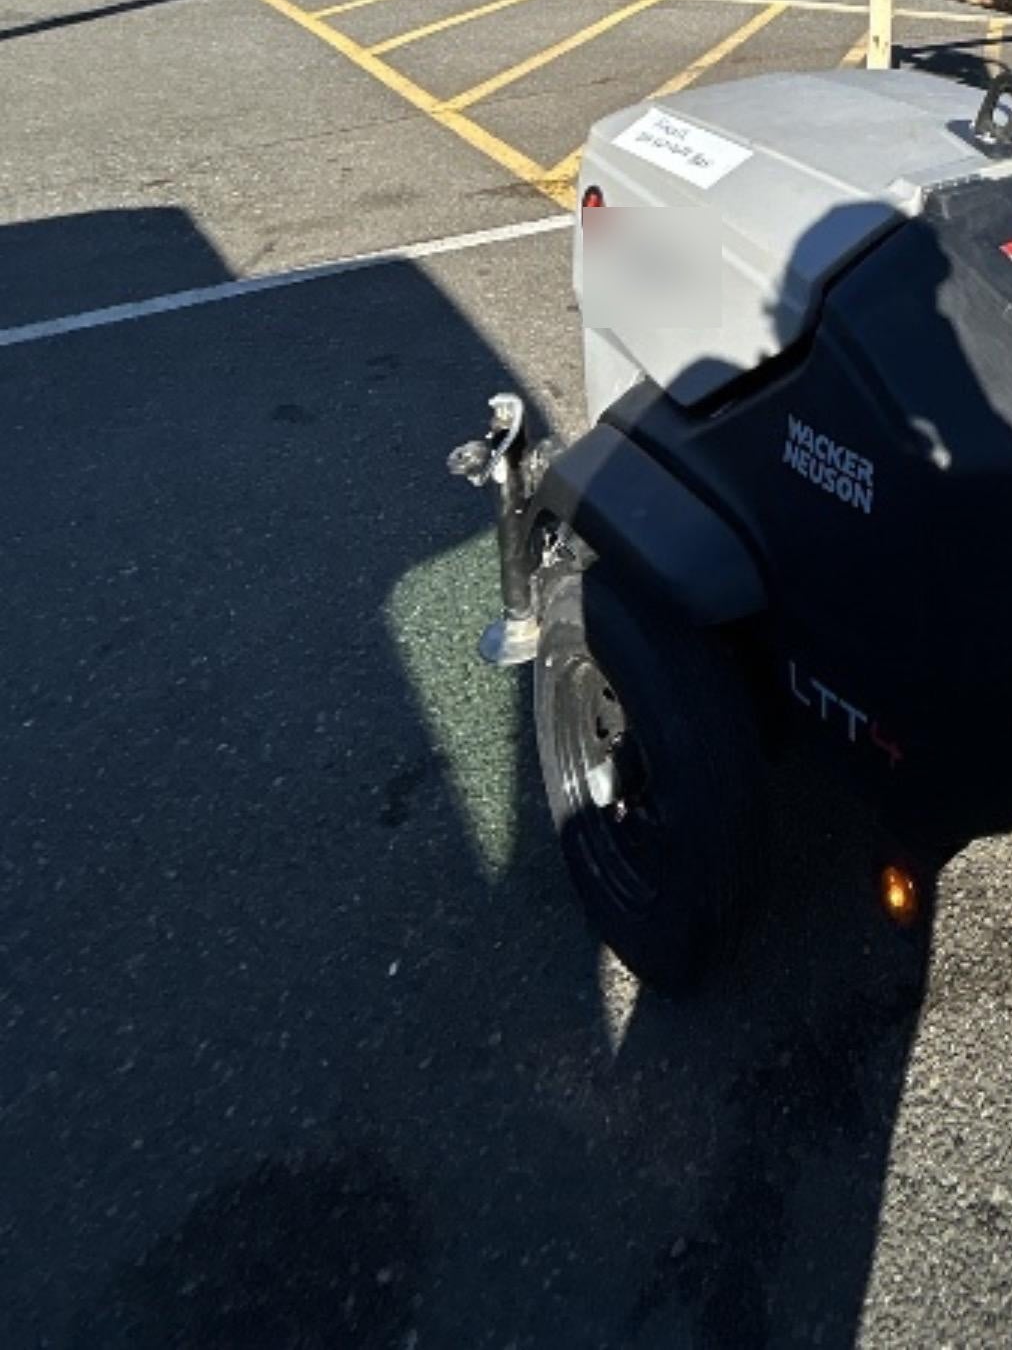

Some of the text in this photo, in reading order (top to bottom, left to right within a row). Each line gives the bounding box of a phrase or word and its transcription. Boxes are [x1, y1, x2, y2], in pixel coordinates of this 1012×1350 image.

[783, 441, 873, 514] NEUSON
[788, 413, 874, 486] WACKER
[789, 660, 903, 769] LTT4
